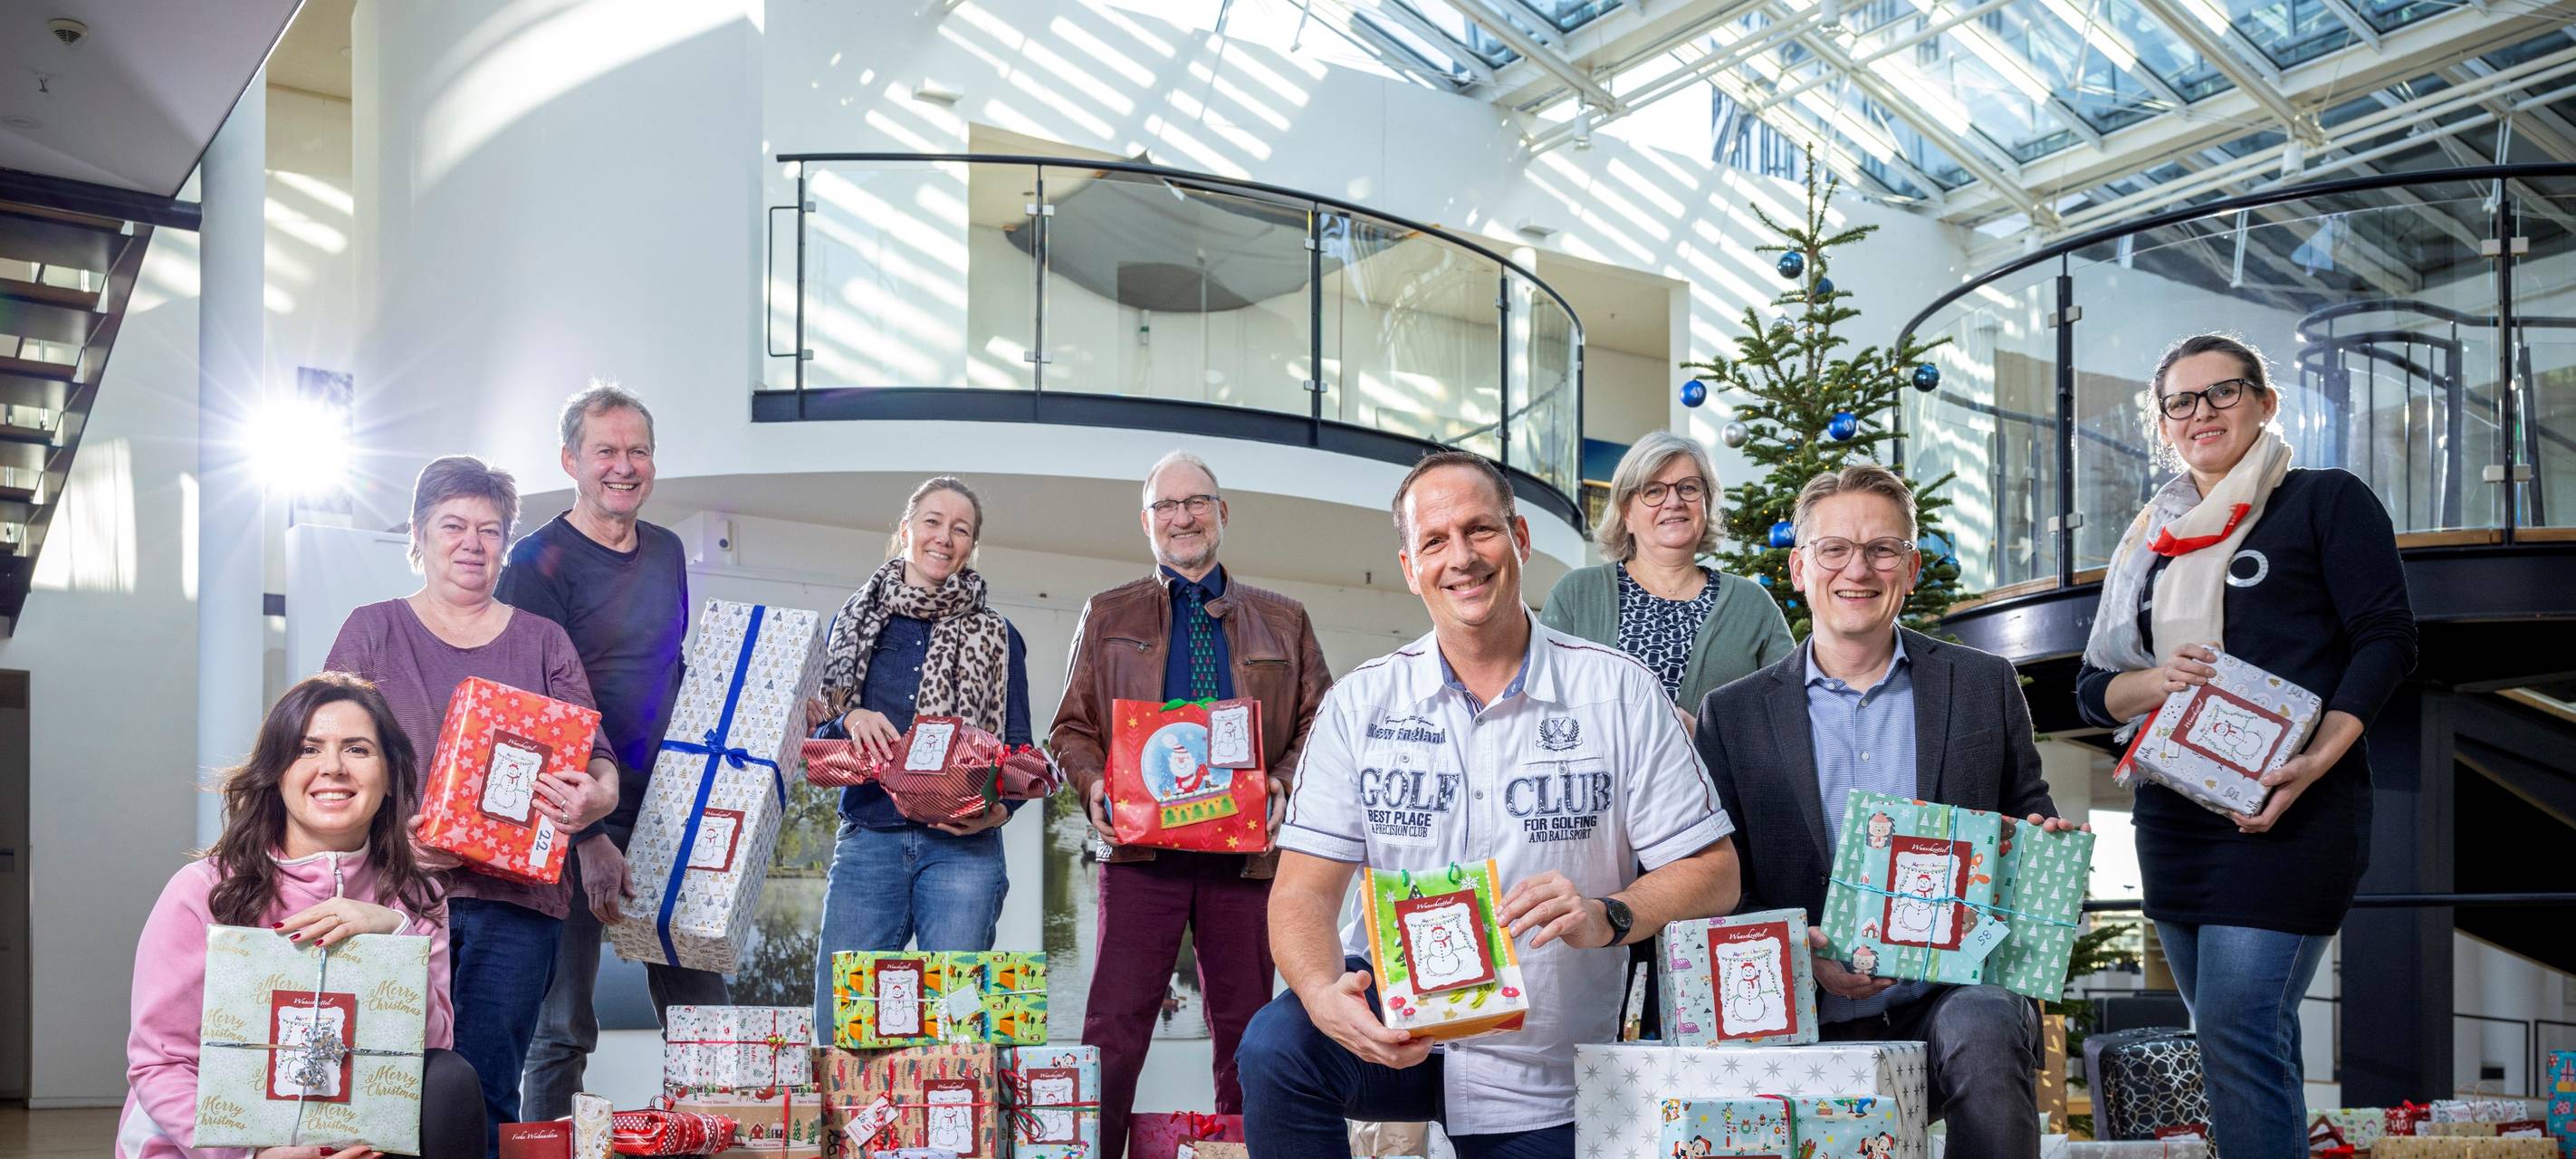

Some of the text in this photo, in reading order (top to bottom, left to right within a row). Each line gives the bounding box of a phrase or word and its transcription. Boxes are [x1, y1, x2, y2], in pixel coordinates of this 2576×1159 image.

[1366, 723, 1395, 740] New
[1360, 767, 1460, 813] GOLF
[1505, 771, 1613, 819] CLUB
[1367, 809, 1432, 827] BEST PLACE
[1524, 815, 1597, 832] FOR GOLFING
[536, 829, 551, 850] 22
[1375, 824, 1408, 837] PRECISION
[1409, 826, 1428, 838] CLUB
[1528, 831, 1547, 843] AND
[367, 979, 420, 1003] Merry
[363, 997, 421, 1016] Christmas
[203, 1028, 247, 1041] hristmas
[364, 1064, 419, 1087] Merry
[362, 1083, 421, 1101] Christmas
[196, 1095, 245, 1117] Merry
[306, 1102, 359, 1122] Merry
[304, 1118, 360, 1135] Christmas
